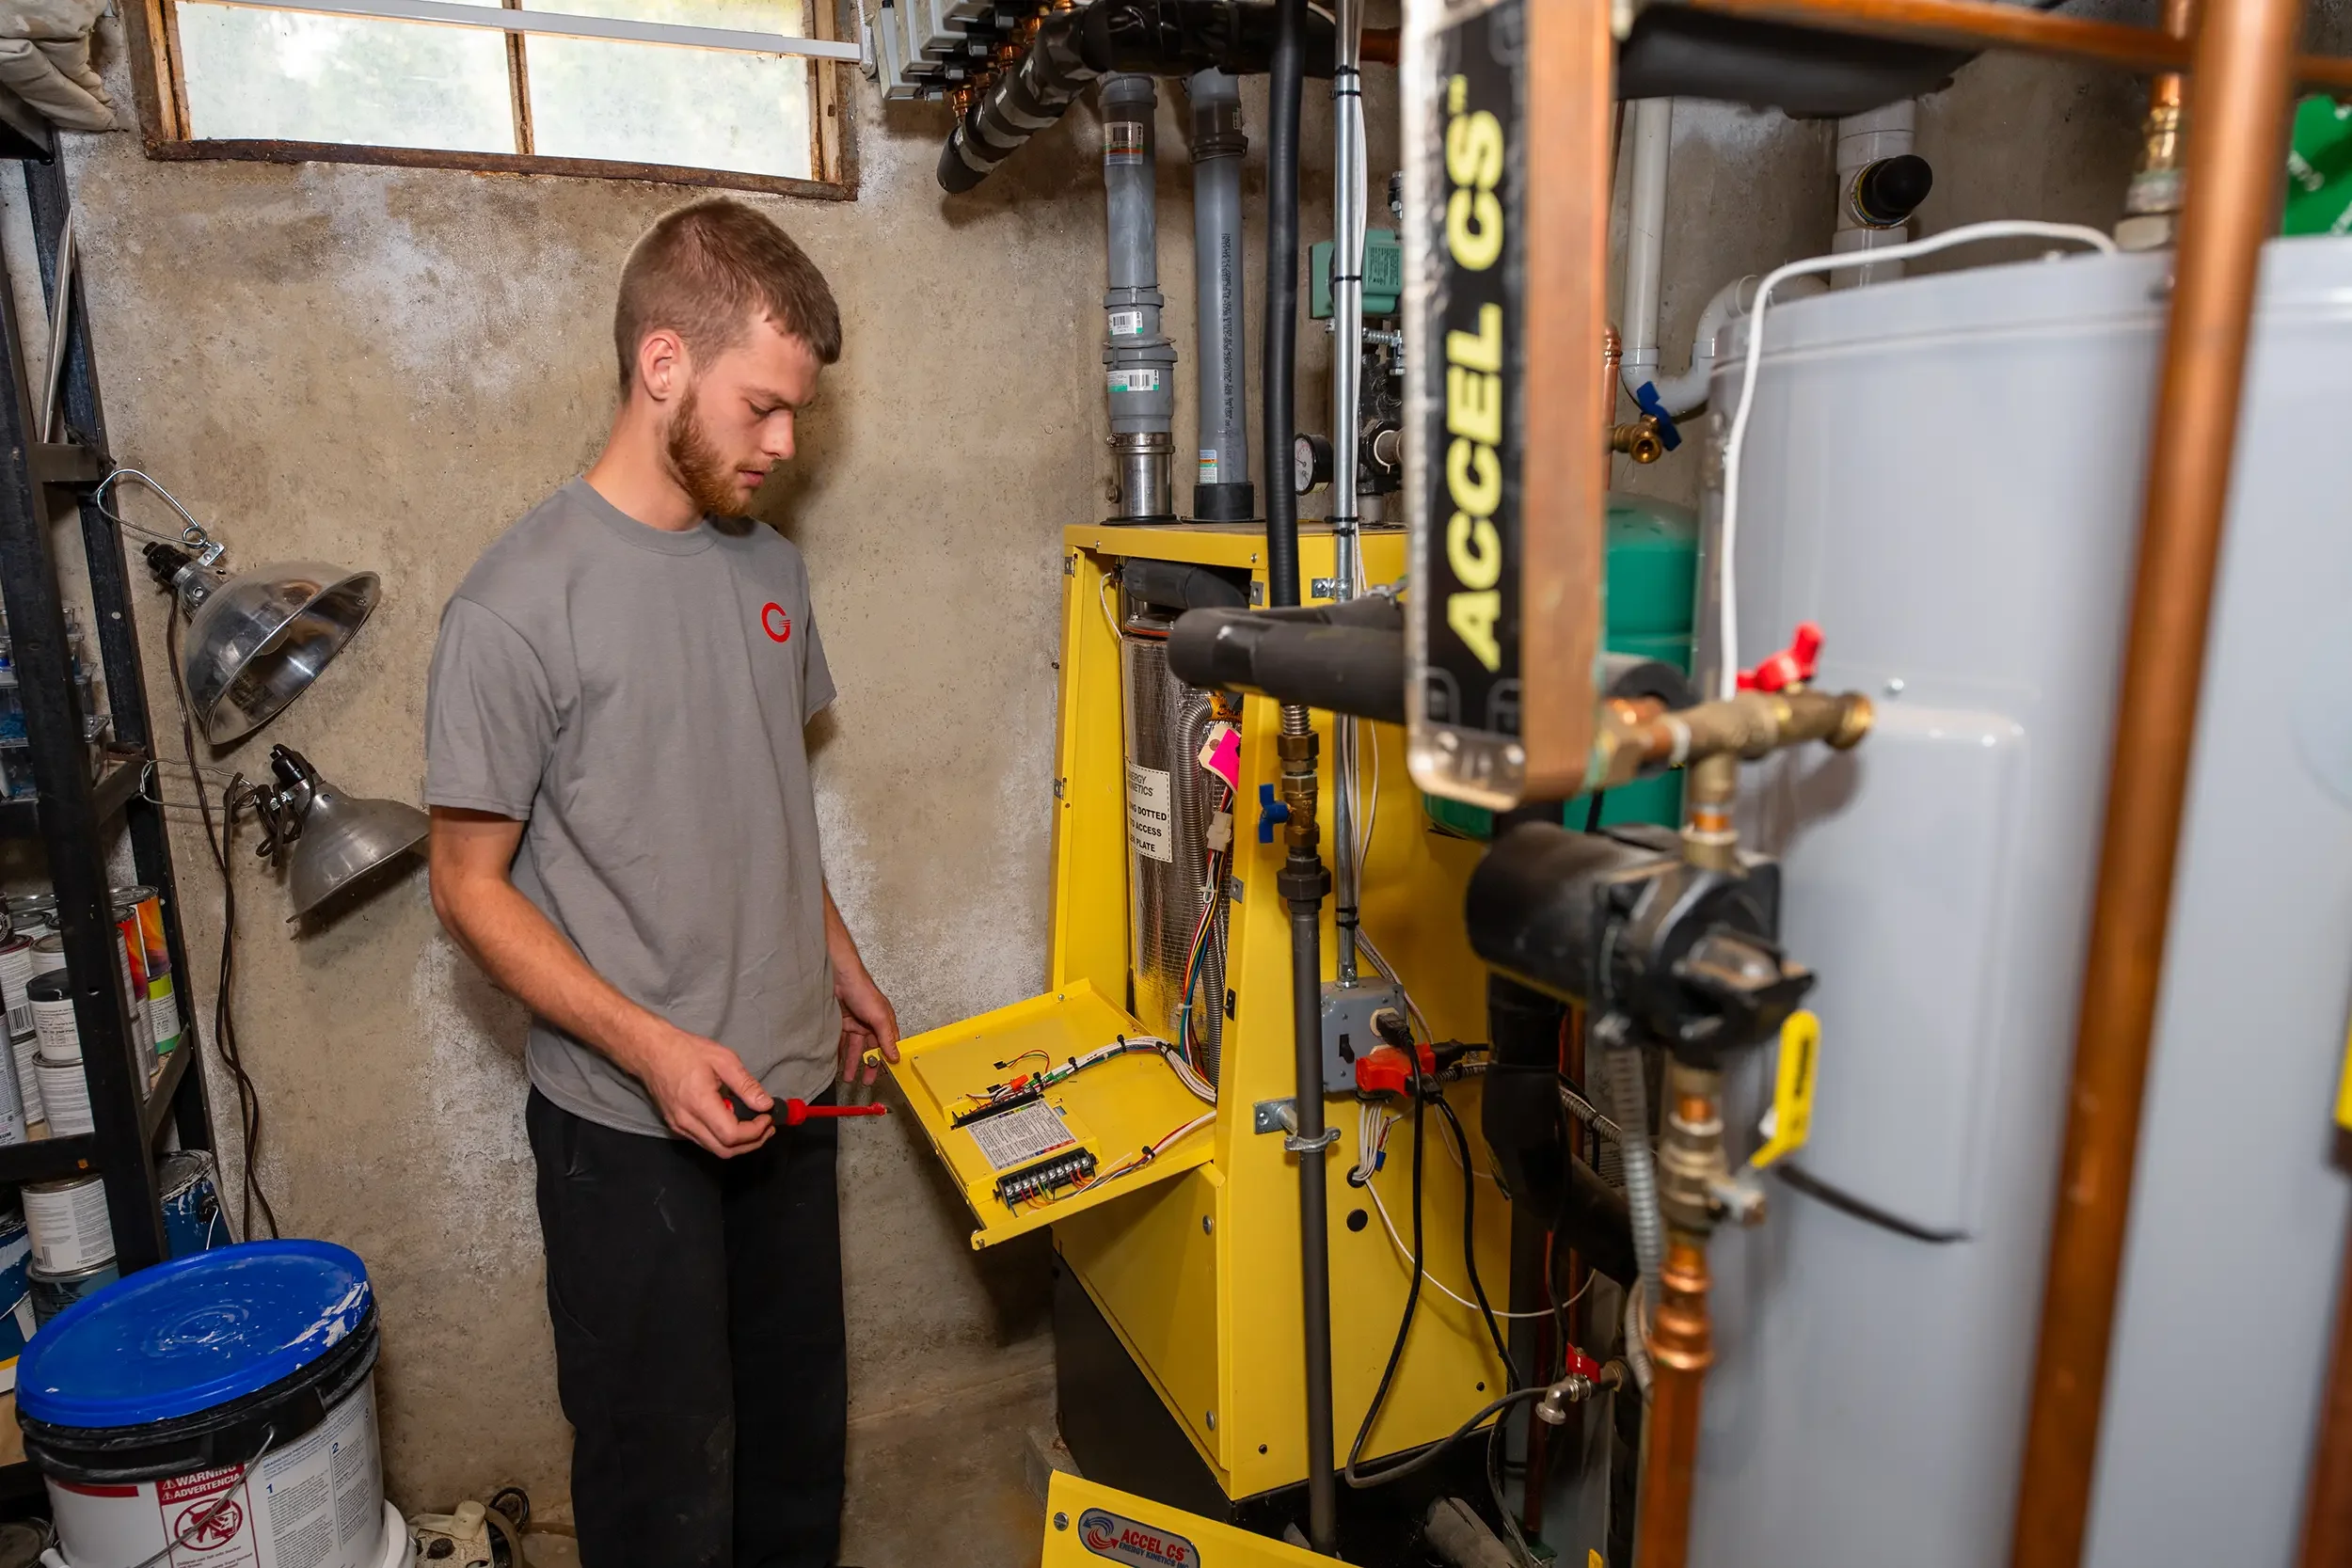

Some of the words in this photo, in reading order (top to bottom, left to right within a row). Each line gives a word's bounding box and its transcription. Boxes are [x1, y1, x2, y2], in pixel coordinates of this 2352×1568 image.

[1446, 302, 1502, 673] ACCEL
[1137, 805, 1168, 821] DOTTED
[1136, 823, 1162, 837] ACCESS
[1136, 837, 1156, 852] PLATE
[332, 1442, 340, 1454] 2
[173, 1473, 241, 1498] ADVERTENCIA
[1120, 1528, 1163, 1555] ACCEL
[1119, 1542, 1146, 1558] ENERGY
[1146, 1550, 1176, 1567] KINETICS
